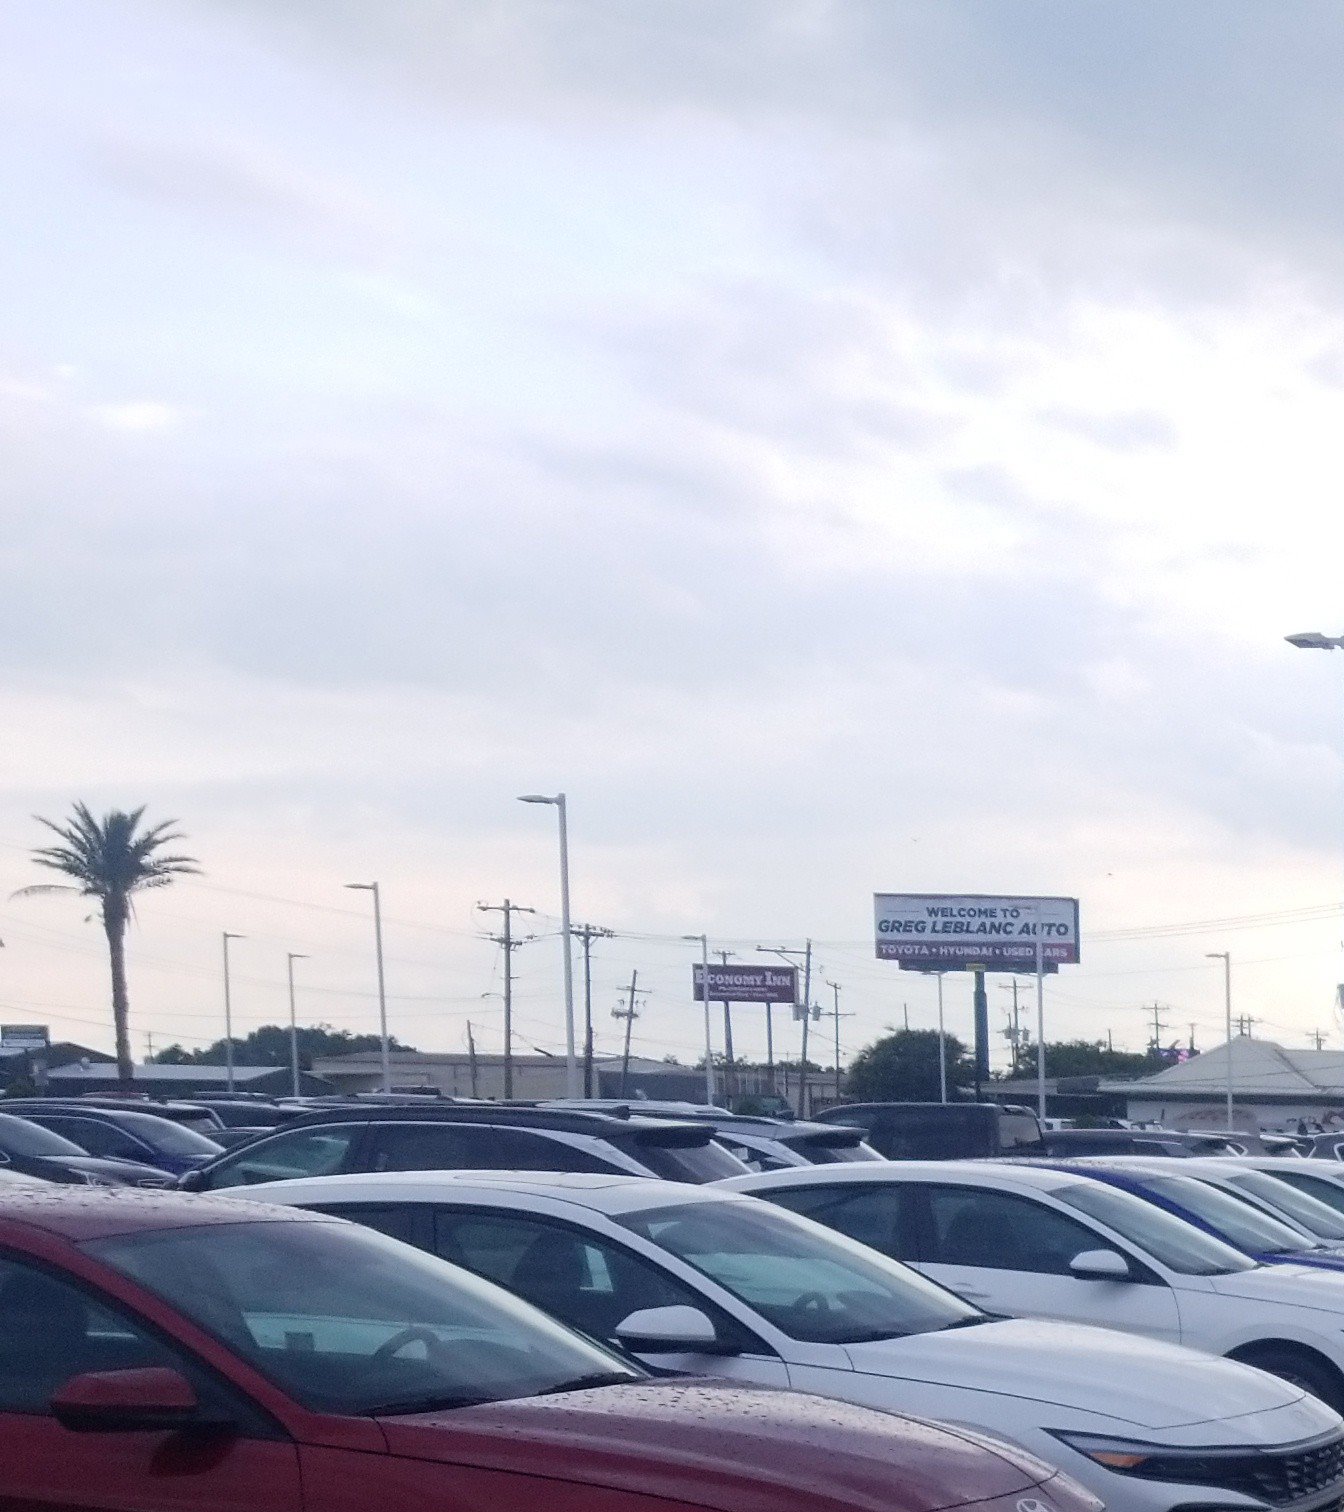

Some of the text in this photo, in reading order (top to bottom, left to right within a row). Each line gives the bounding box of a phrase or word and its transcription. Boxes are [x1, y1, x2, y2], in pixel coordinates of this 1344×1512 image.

[926, 906, 1021, 919] WELCOME TO
[878, 919, 927, 934] GREG
[930, 921, 1014, 936] LEBLANC
[881, 945, 1068, 957] TOYOTA HYUNDAI USED ARS
